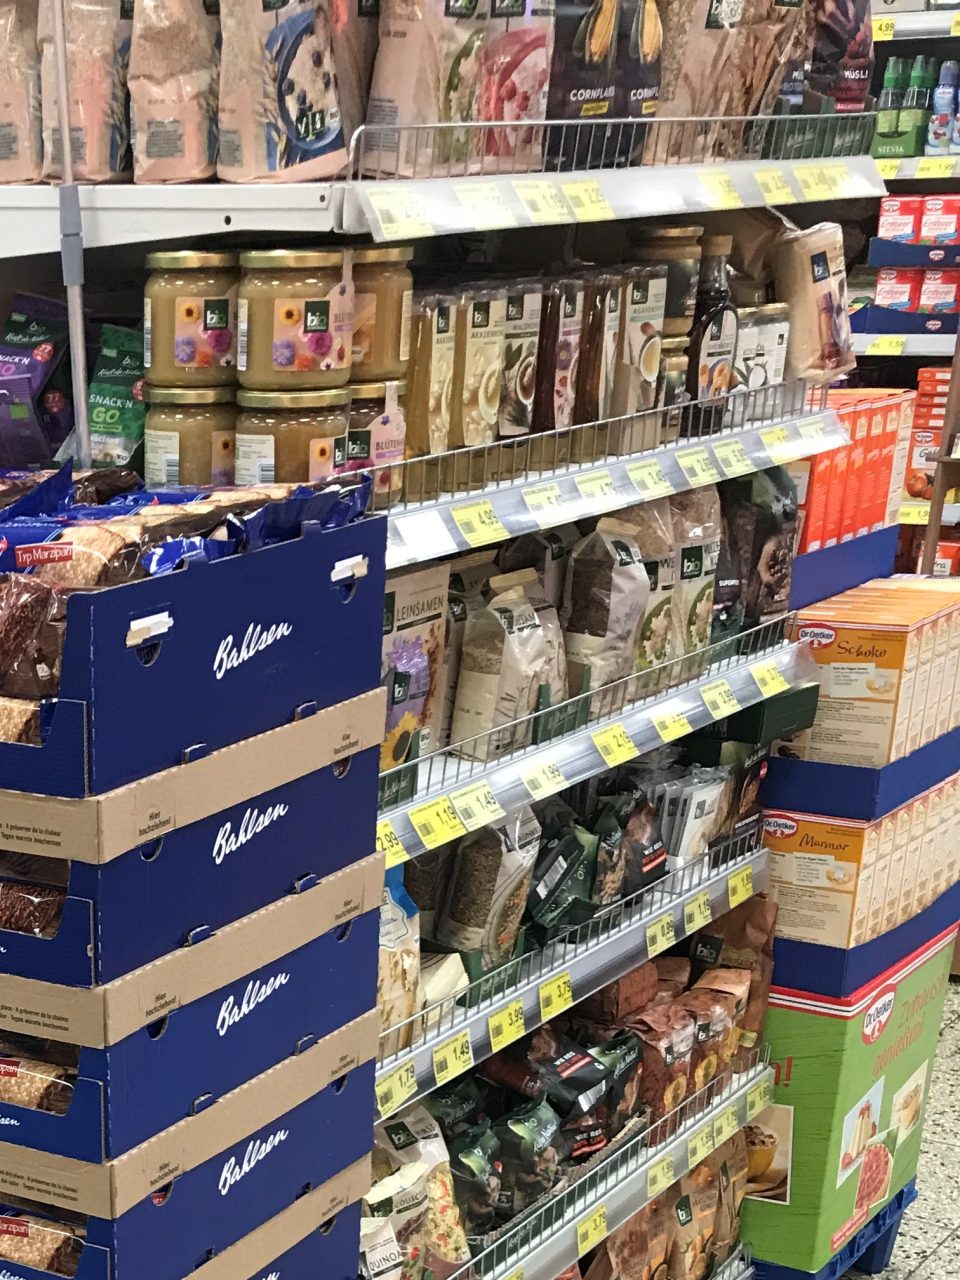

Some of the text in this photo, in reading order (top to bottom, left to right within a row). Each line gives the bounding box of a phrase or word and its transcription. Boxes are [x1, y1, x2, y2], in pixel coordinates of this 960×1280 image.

[844, 68, 868, 80] MÜSLI
[207, 311, 226, 323] bio
[307, 312, 327, 326] bio
[90, 394, 133, 408] SNACK'N
[92, 407, 120, 423] GO
[16, 546, 73, 564] Typ Marzipan
[683, 558, 700, 573] bio
[396, 594, 444, 622] LEINSAMEN
[213, 622, 292, 680] Bahlsen
[837, 641, 888, 658] Schoko
[148, 810, 161, 822] Hier
[436, 804, 456, 823] 1,19
[213, 803, 289, 865] Bahlsen
[379, 833, 399, 851] 2,99
[800, 833, 850, 852] Marmor
[216, 972, 290, 1037] Bahlsen
[507, 1009, 524, 1029] 3,99
[452, 1040, 470, 1060] 1,49
[398, 1066, 416, 1088] 1,79
[218, 1129, 289, 1196] Bahlsen
[369, 1250, 403, 1272] QUINOA
